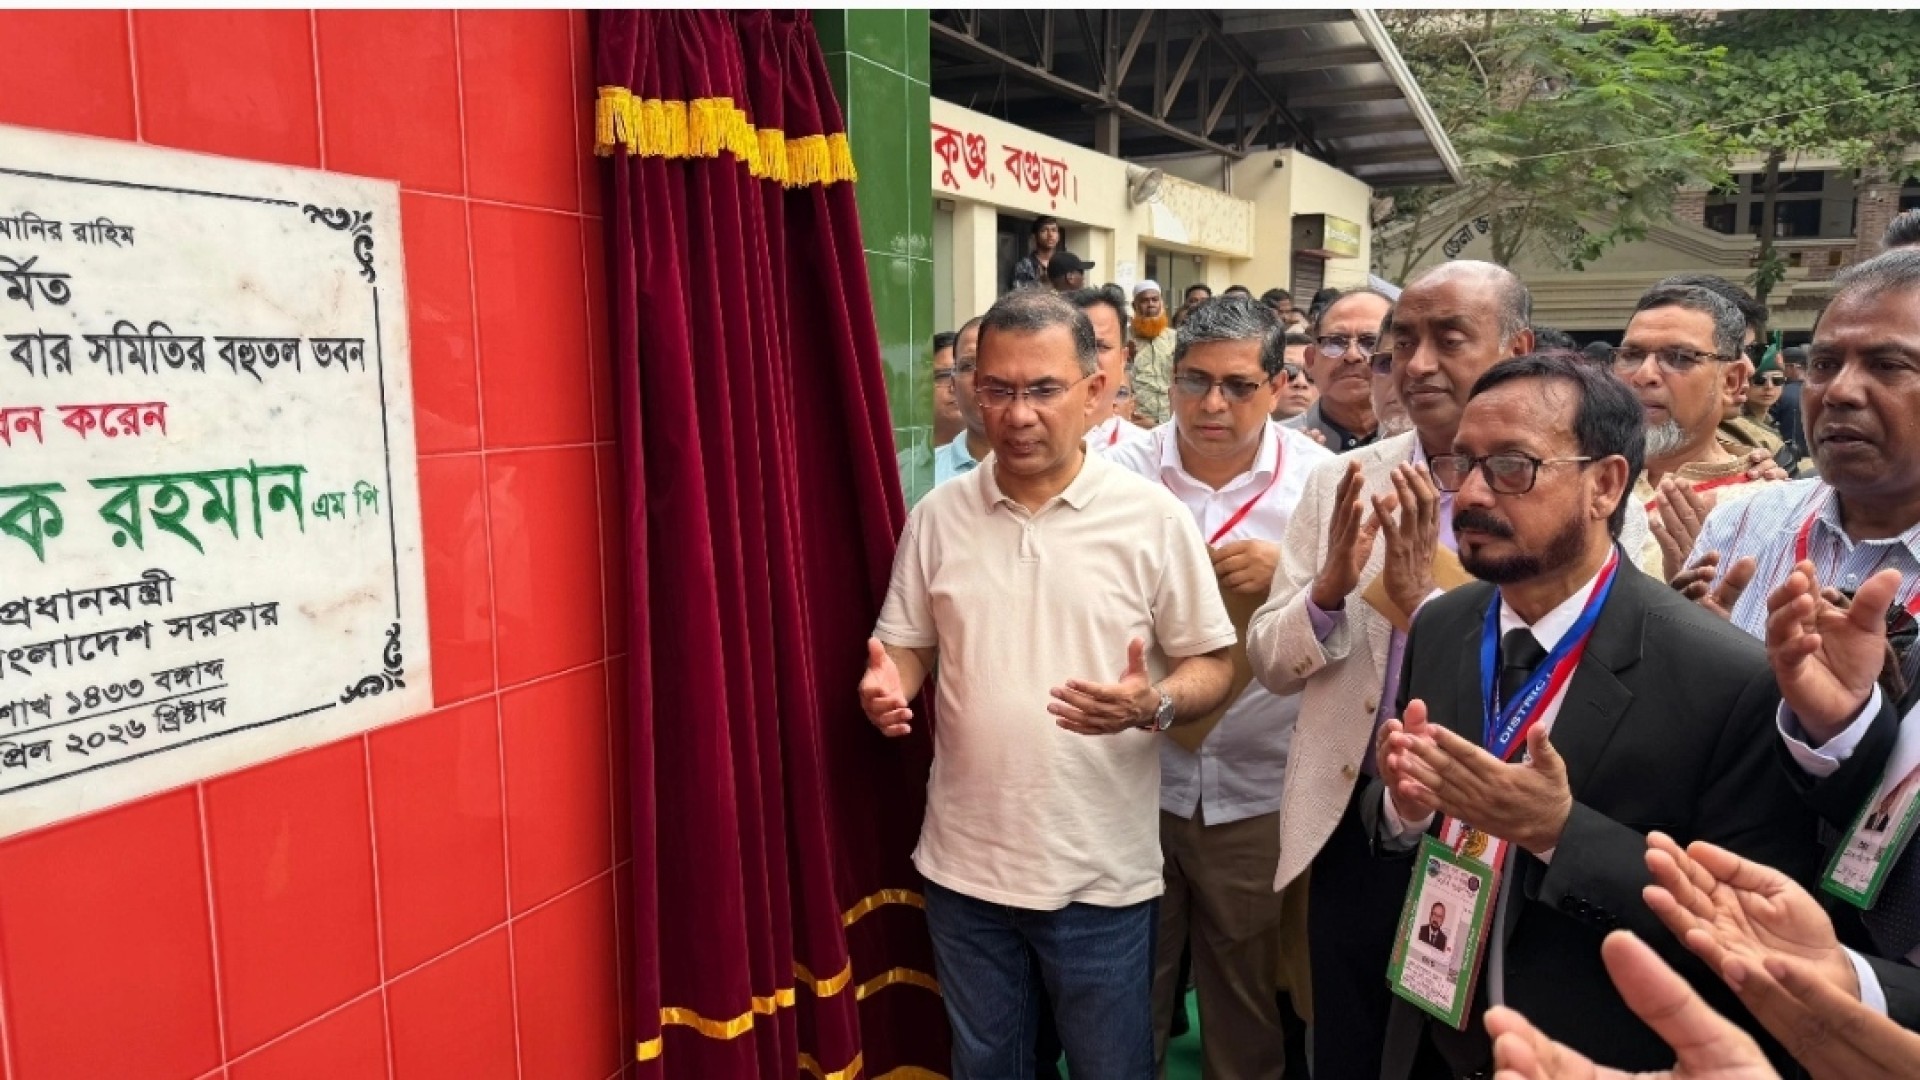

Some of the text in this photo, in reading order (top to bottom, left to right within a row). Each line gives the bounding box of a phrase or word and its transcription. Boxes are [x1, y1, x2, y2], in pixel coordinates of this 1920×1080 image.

[70, 216, 134, 247] রাহিম
[4, 320, 365, 383] বার সমিতির বহুতল ভবন
[56, 401, 169, 437] করেন
[87, 459, 307, 554] রহমান
[312, 491, 346, 520] এম
[354, 479, 379, 515] পি
[163, 601, 279, 641] সরকার
[66, 678, 144, 715] ১৪৩৩
[151, 658, 224, 692] বঙ্গাব্দ
[1499, 672, 1552, 744] DISTRIC
[66, 719, 146, 756] ২০২৬
